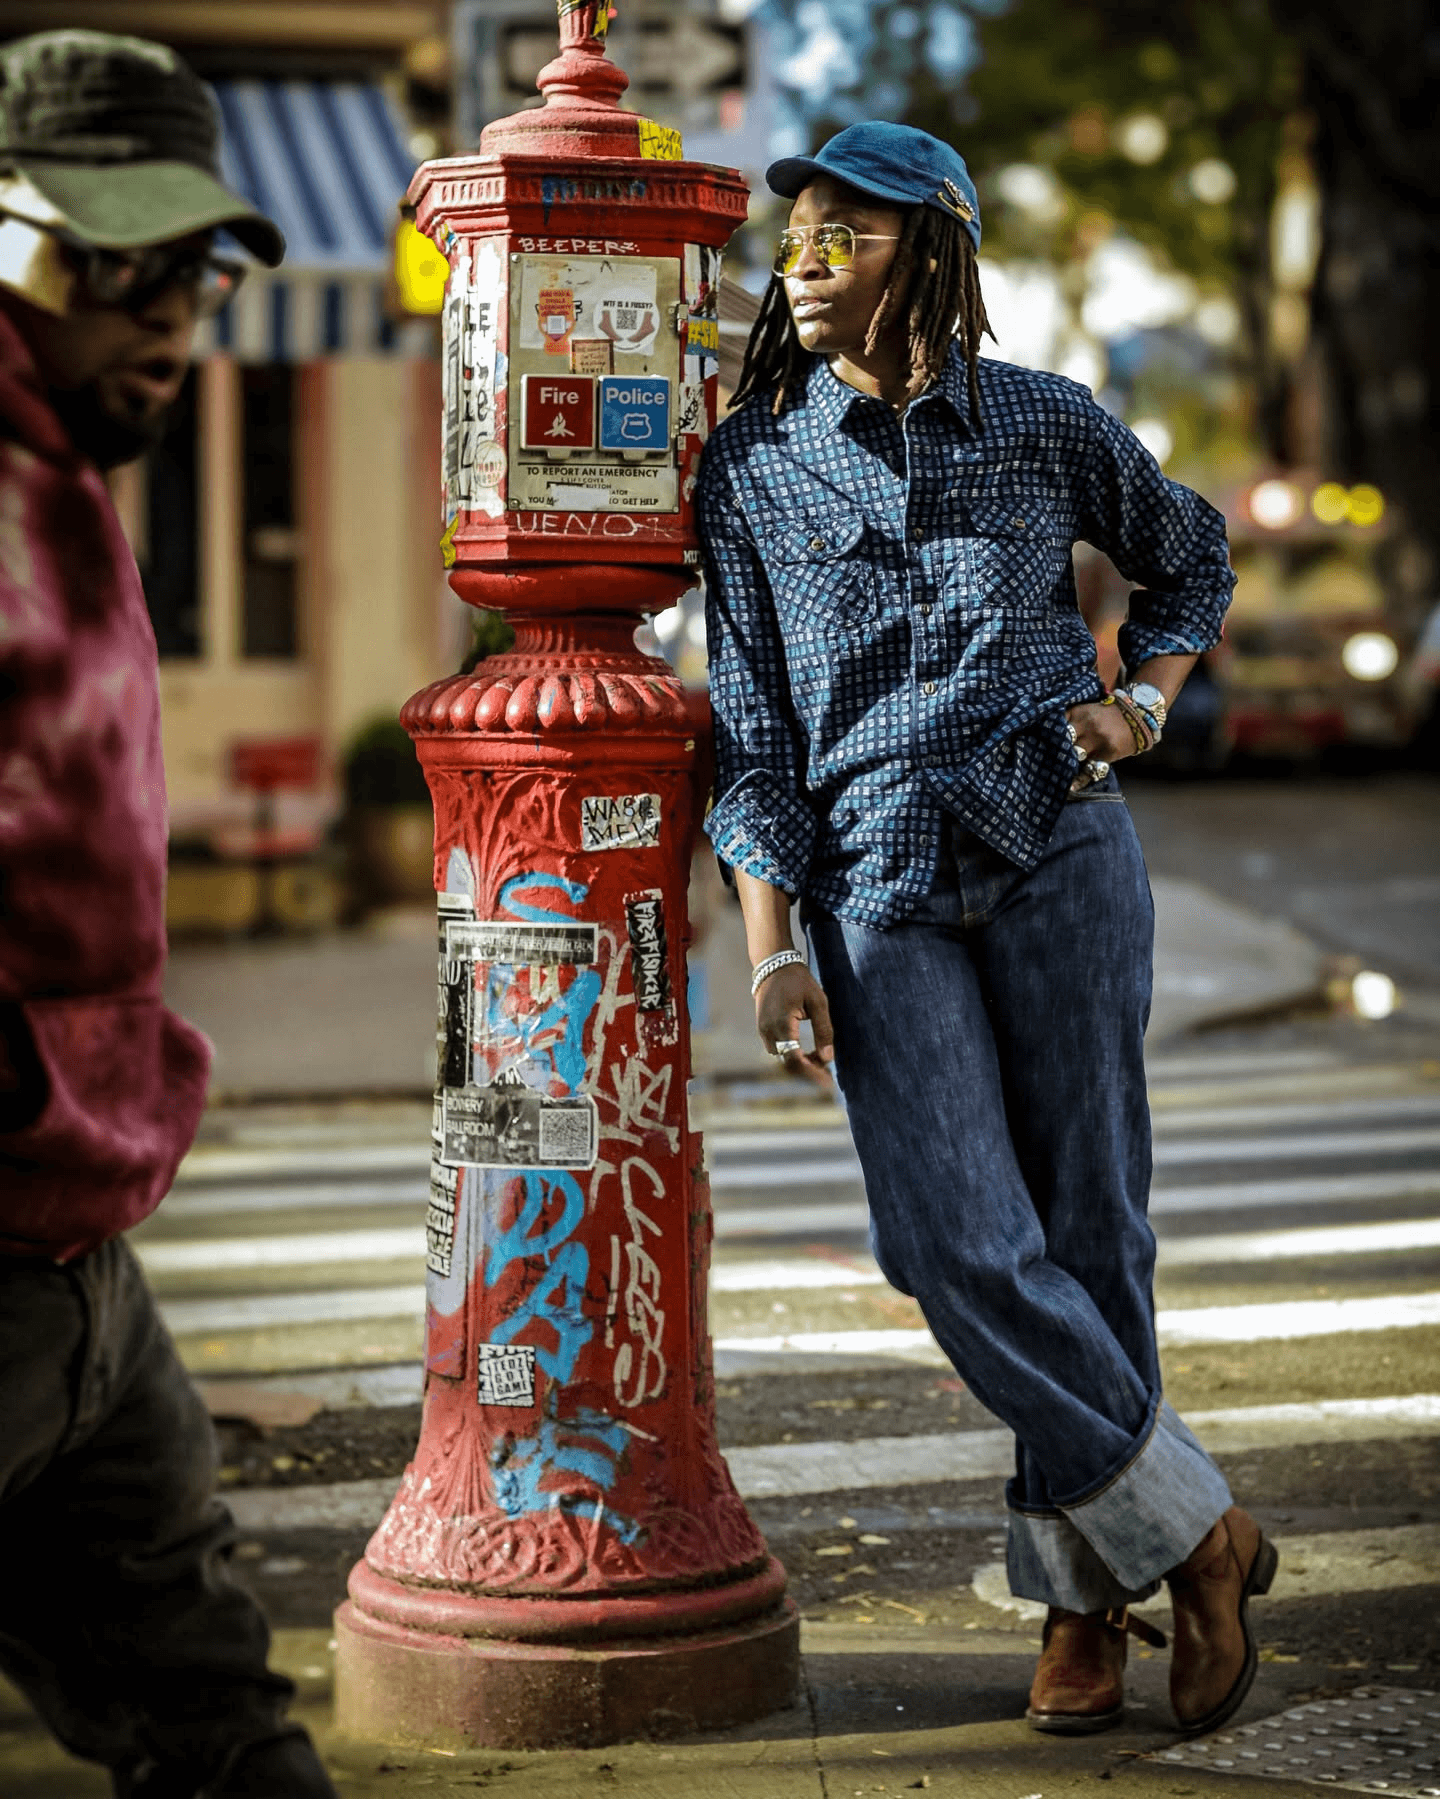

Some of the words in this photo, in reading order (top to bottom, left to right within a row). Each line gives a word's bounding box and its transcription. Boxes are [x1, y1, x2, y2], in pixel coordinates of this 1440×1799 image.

[540, 386, 580, 405] Fire
[605, 386, 666, 405] Police
[527, 467, 540, 476] TO
[542, 467, 579, 476] REPORT
[581, 468, 597, 477] AN
[599, 468, 659, 478] EMERGENCY
[528, 496, 545, 504] YOU
[622, 498, 638, 506] GET
[640, 498, 660, 506] HELP
[446, 1096, 484, 1113] BOWERY
[446, 1119, 495, 1137] BALLROOM
